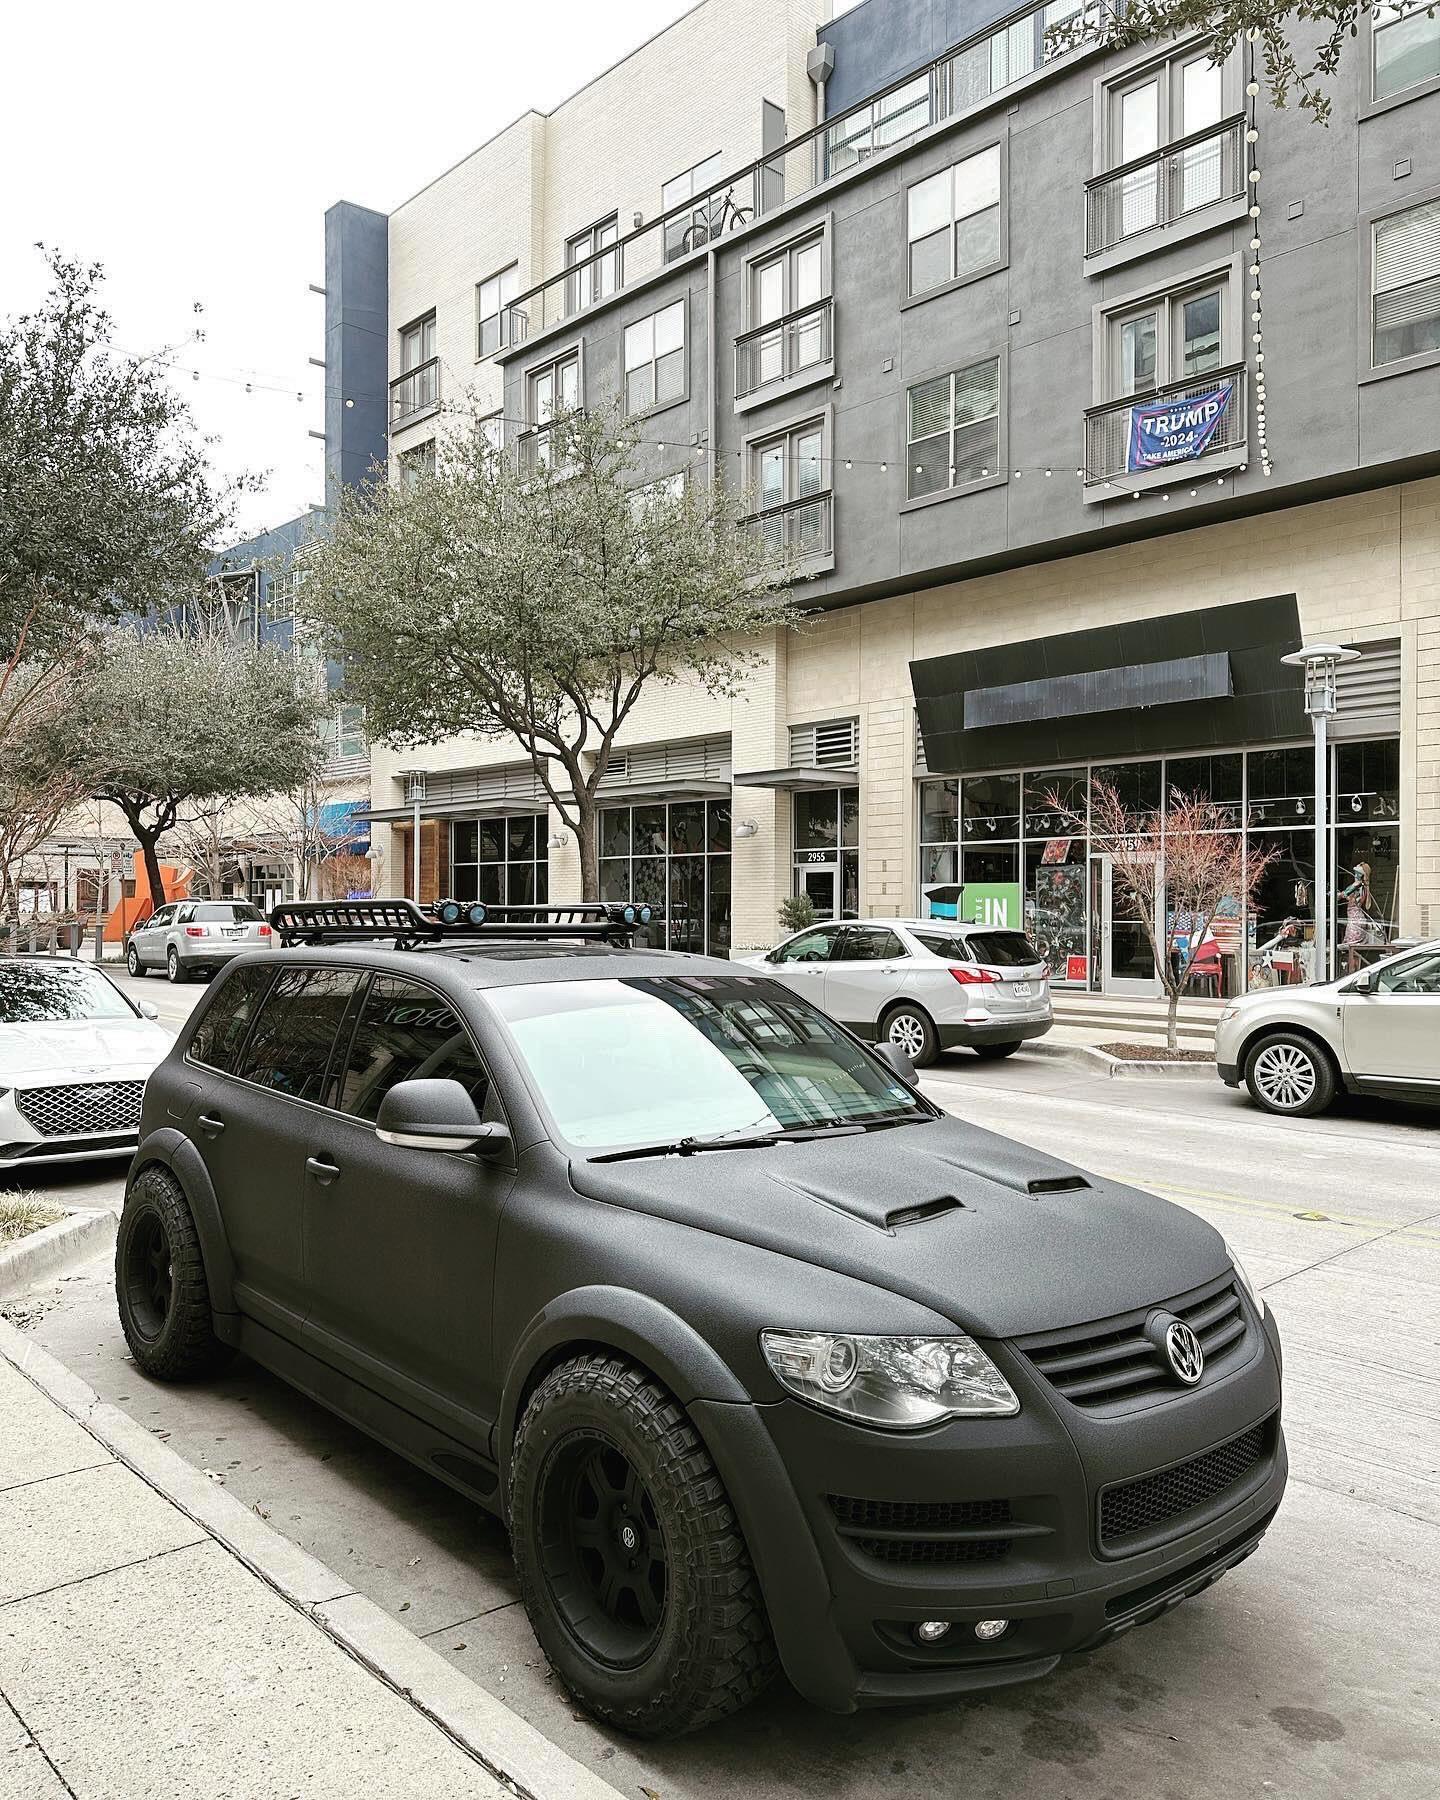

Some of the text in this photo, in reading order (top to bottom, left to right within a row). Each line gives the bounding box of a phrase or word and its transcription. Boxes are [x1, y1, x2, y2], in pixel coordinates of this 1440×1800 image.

[1143, 401, 1219, 435] TRUMP
[1142, 445, 1194, 461] TAKE AMERICA
[807, 852, 826, 862] 2955
[985, 898, 1008, 927] IN
